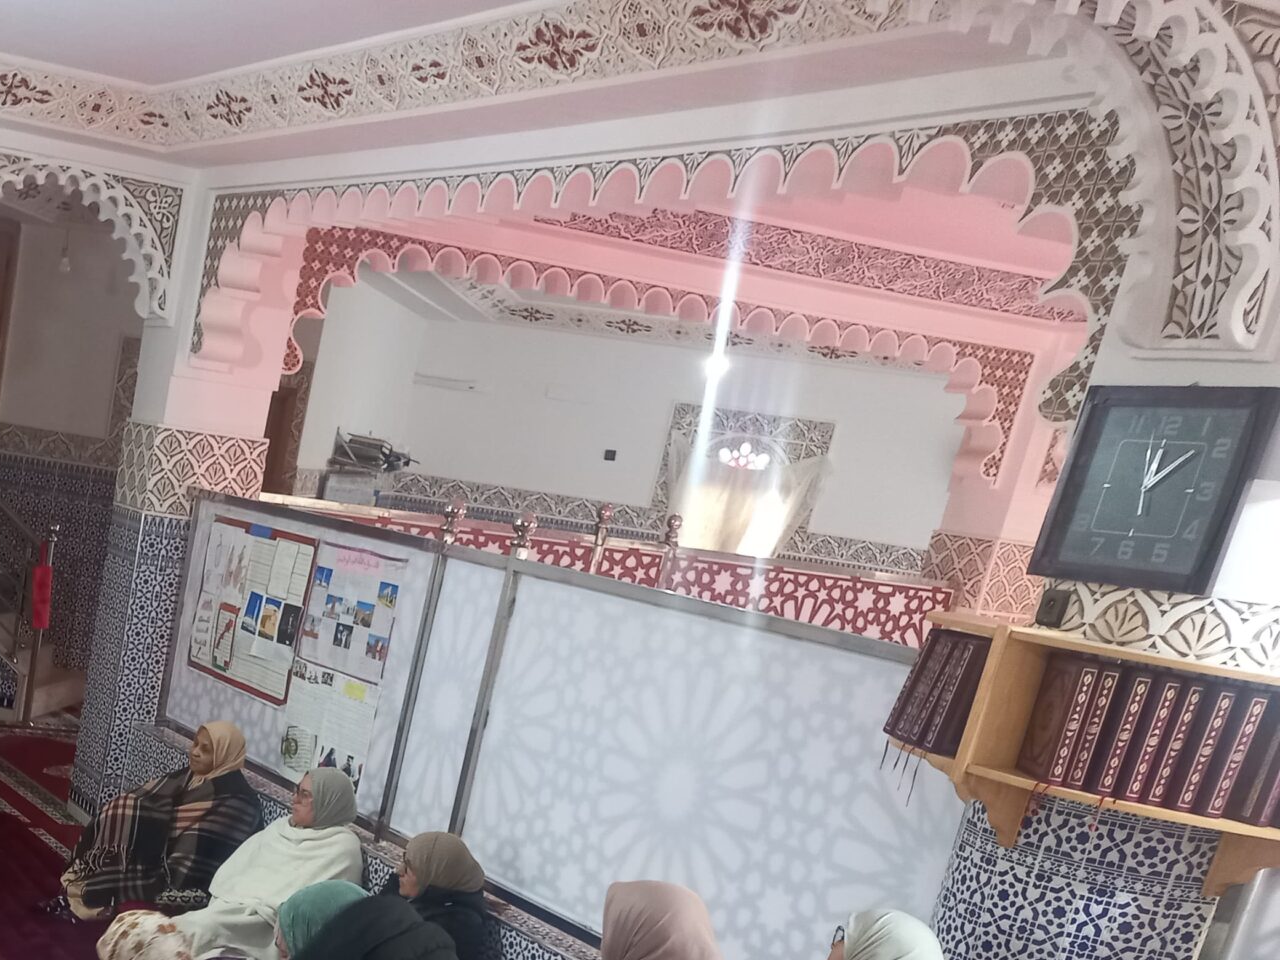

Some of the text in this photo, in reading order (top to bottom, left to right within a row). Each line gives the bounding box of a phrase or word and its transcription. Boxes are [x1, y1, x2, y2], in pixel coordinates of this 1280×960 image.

[1128, 415, 1146, 433] 11
[1156, 415, 1183, 435] 12
[1201, 416, 1211, 436] 1
[1211, 438, 1232, 458] 2
[1195, 481, 1216, 501] 3
[1182, 519, 1200, 541] 4
[1089, 537, 1105, 557] 7
[1117, 540, 1135, 560] 6
[1151, 543, 1169, 563] 5
